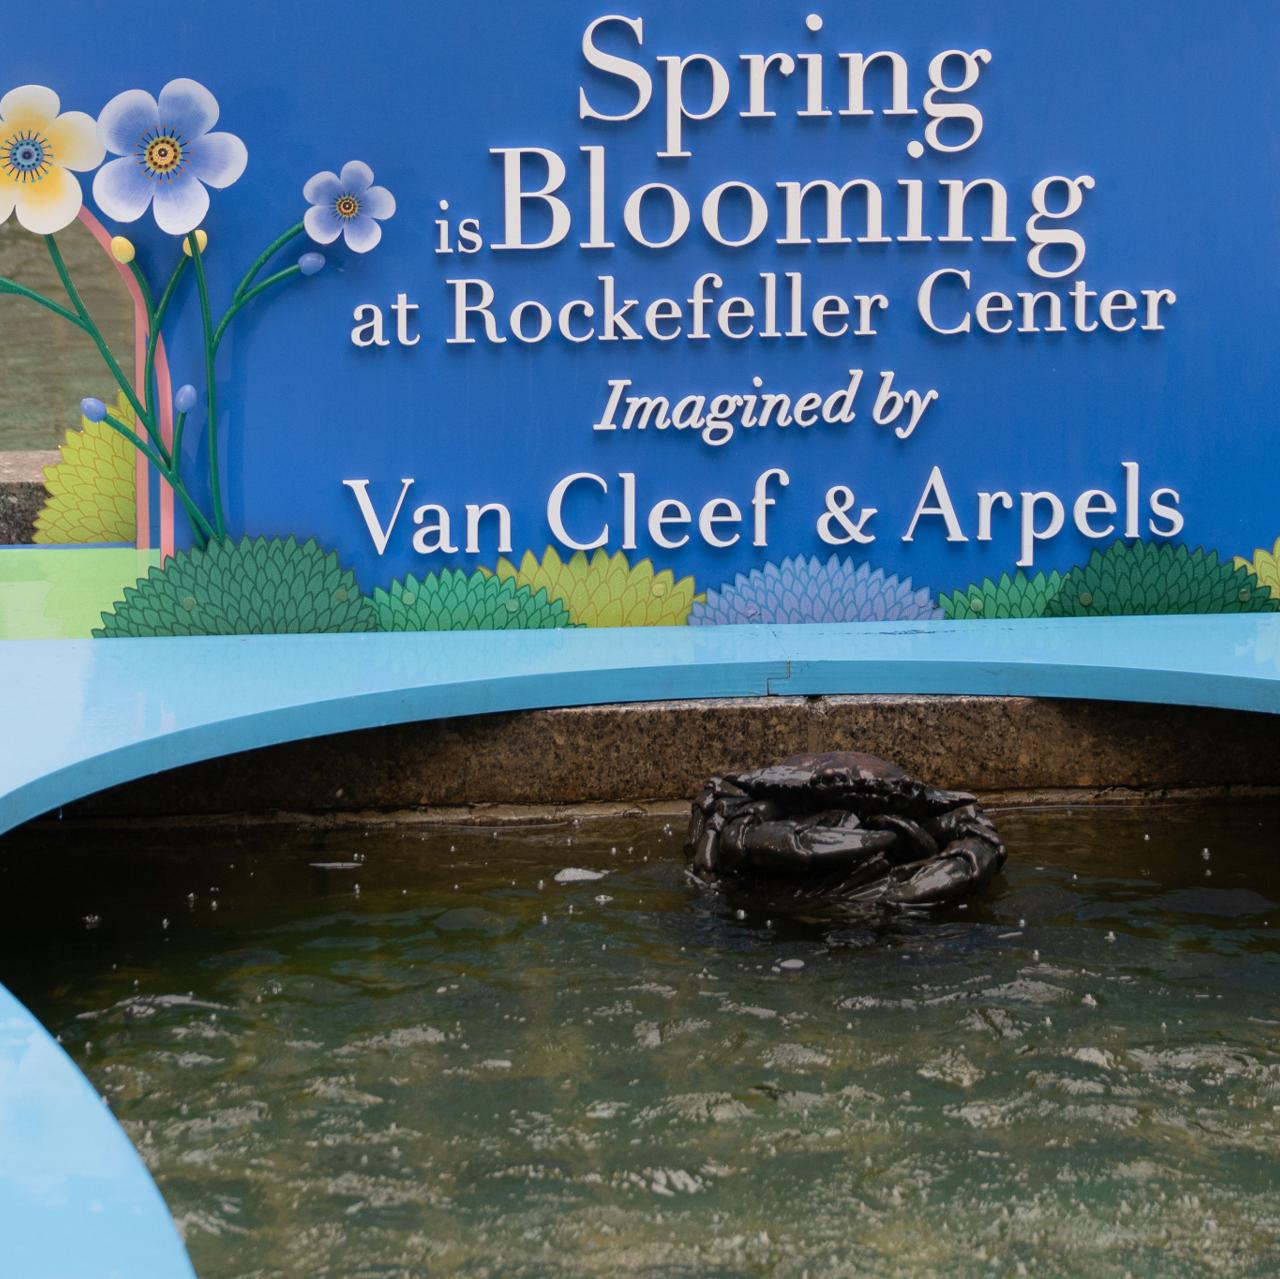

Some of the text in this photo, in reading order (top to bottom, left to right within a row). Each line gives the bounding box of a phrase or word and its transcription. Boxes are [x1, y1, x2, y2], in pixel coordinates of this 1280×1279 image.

[579, 13, 992, 158] Spring
[435, 140, 1095, 279] is Blooming
[351, 268, 1177, 347] at Rockefeller Center
[593, 369, 939, 446] Imagined by
[342, 462, 1184, 567] Van Cleef & Arpels
